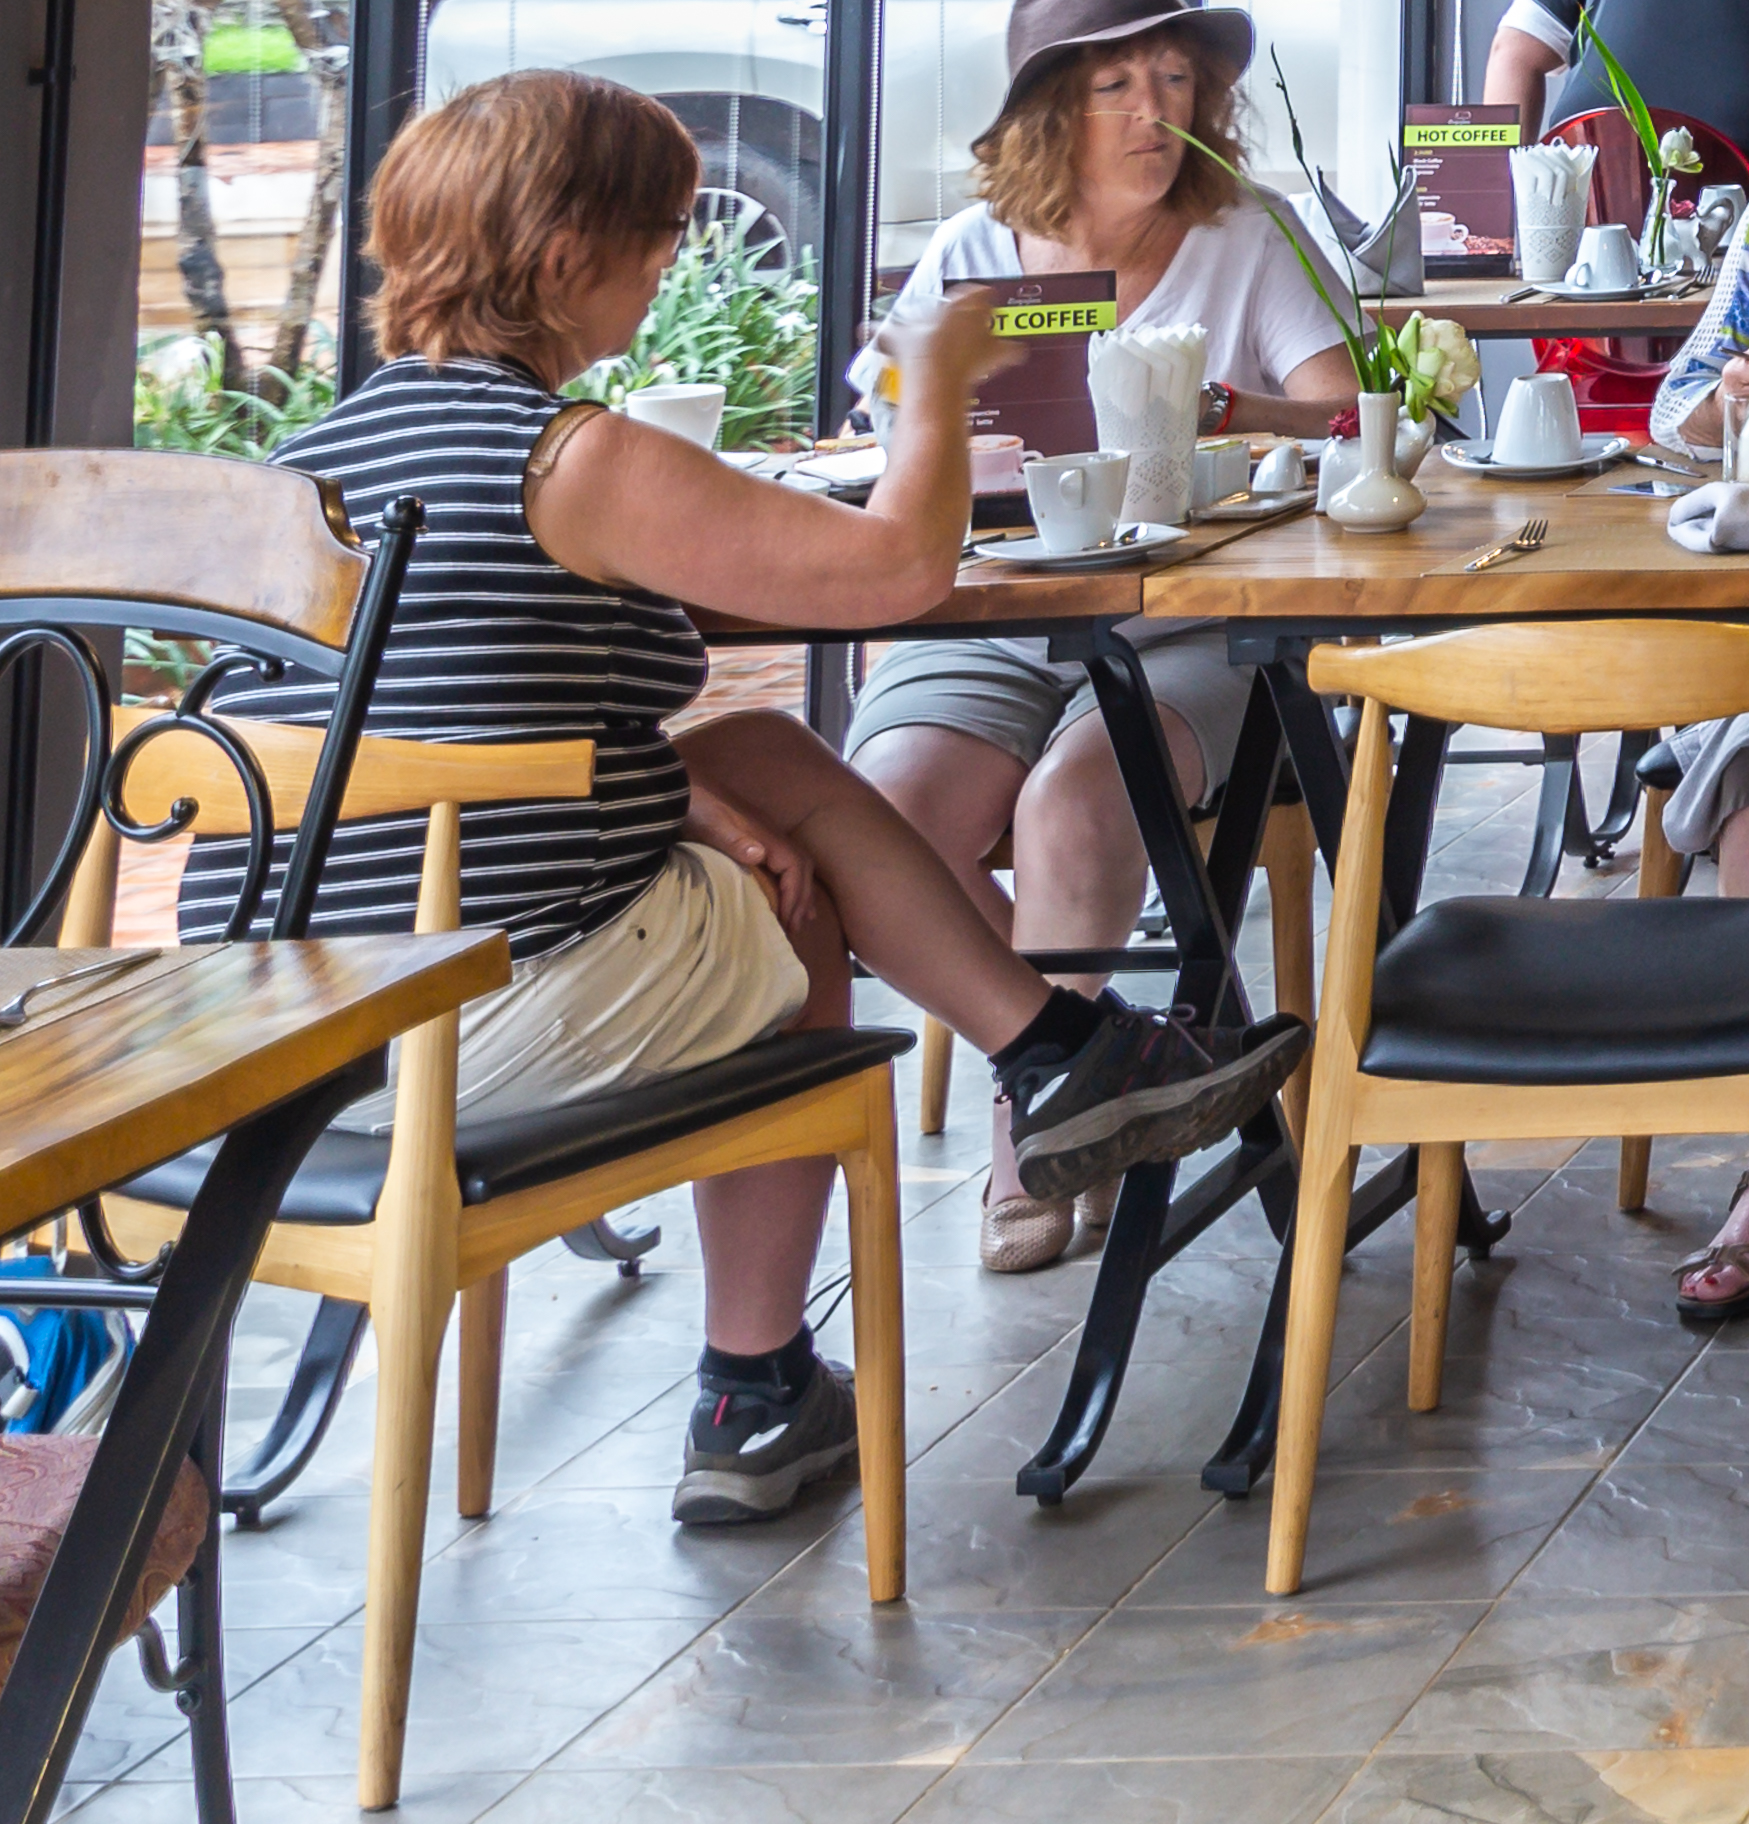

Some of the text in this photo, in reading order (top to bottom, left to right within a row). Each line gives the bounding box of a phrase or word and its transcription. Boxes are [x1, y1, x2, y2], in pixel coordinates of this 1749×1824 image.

[1417, 129, 1508, 143] HOT COFFEE
[1014, 309, 1098, 330] COFFEE
